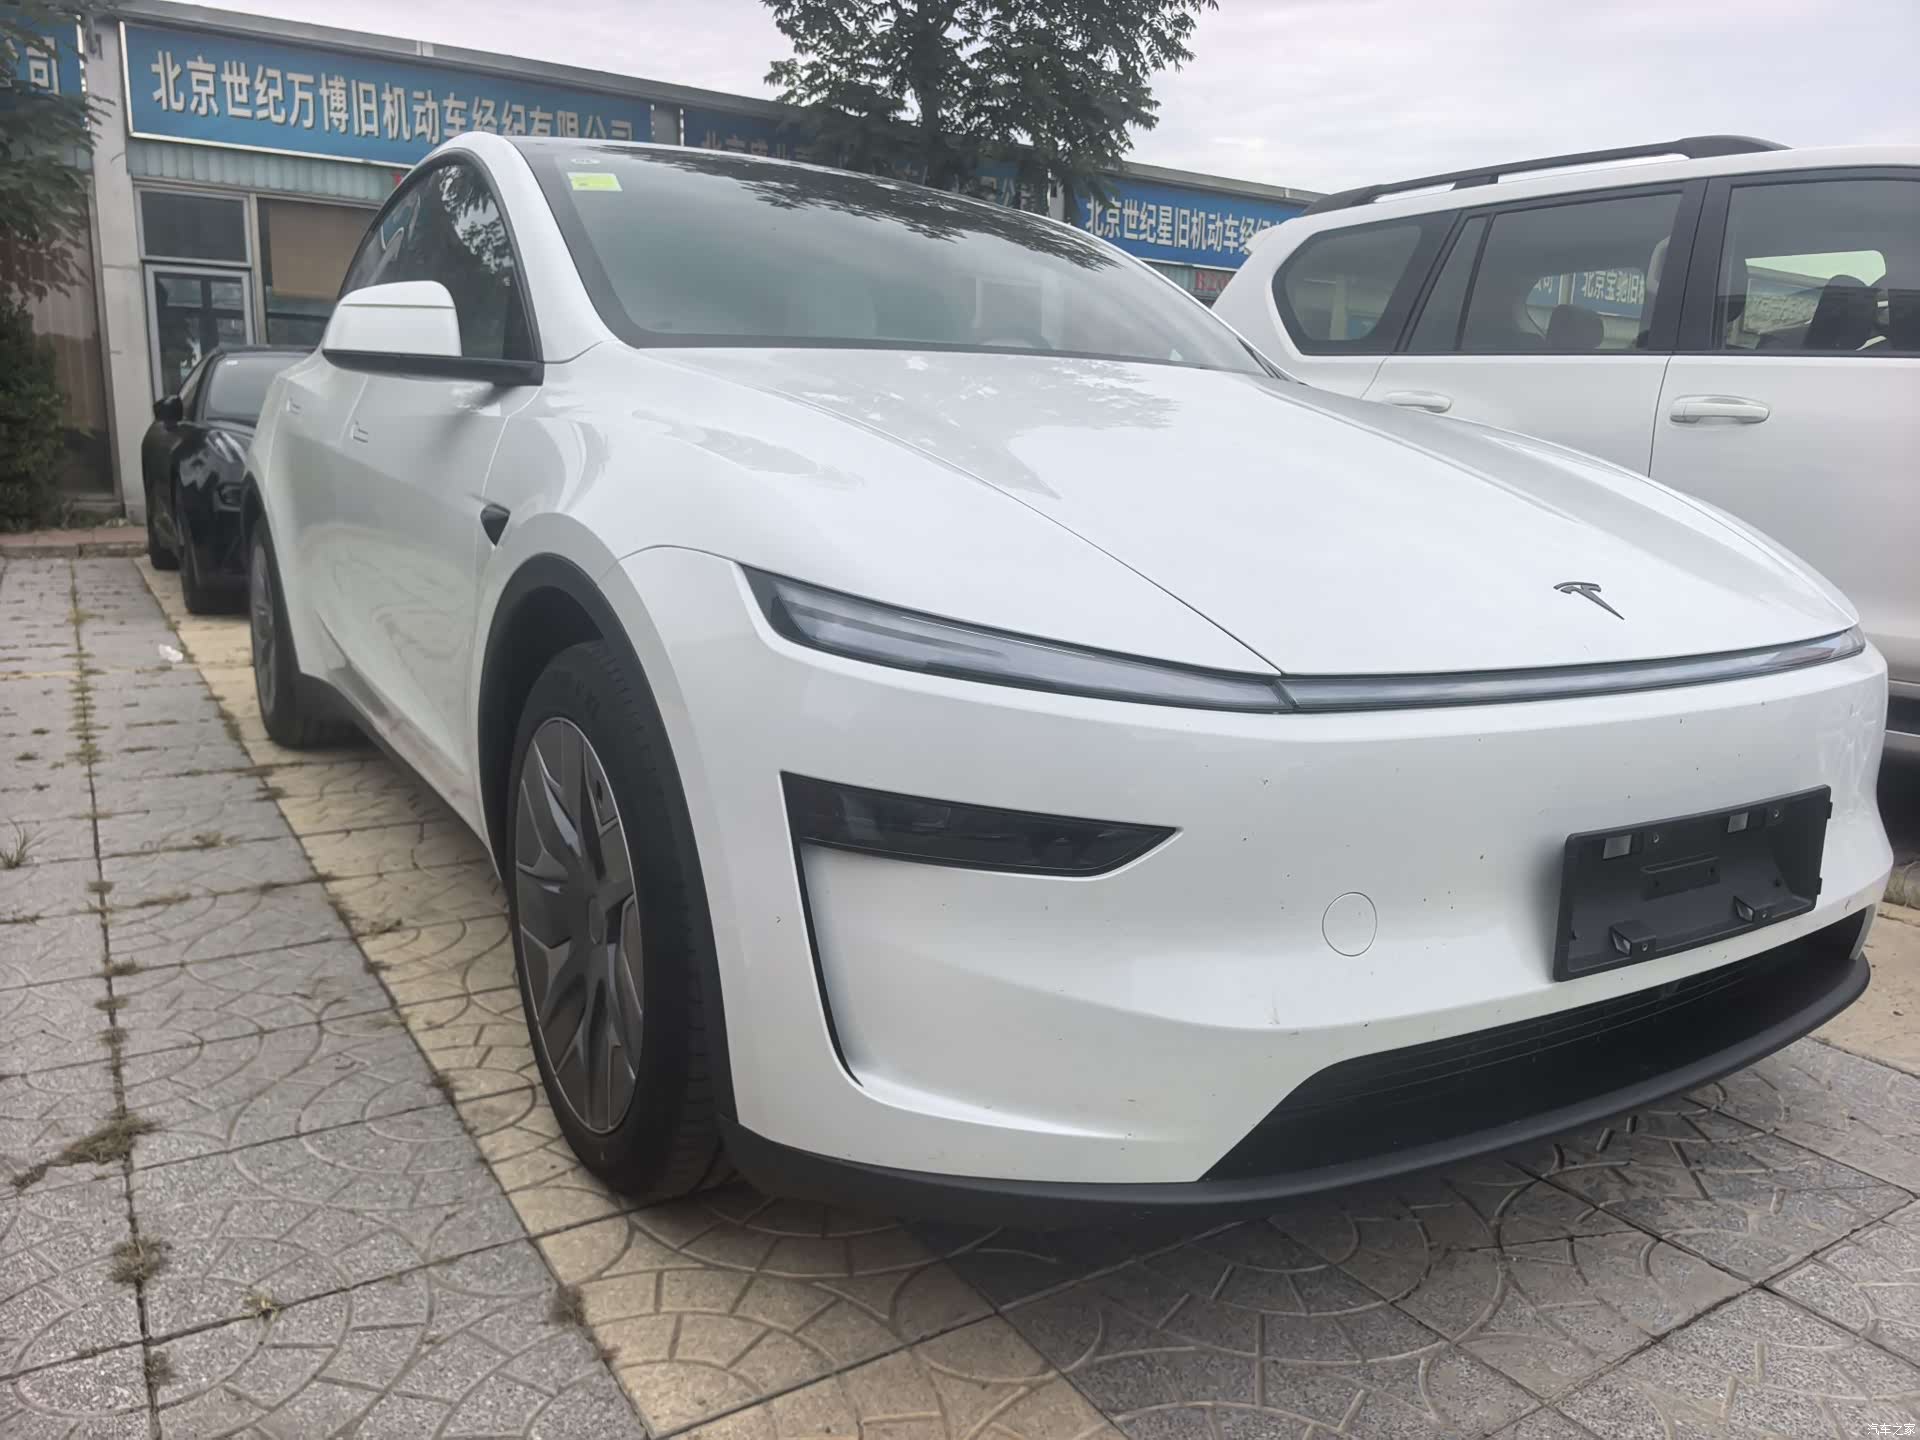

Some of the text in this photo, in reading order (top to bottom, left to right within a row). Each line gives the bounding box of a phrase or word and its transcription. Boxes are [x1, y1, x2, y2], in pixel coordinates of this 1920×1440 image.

[1085, 194, 1280, 255] 北京世纪星旧机动车经
